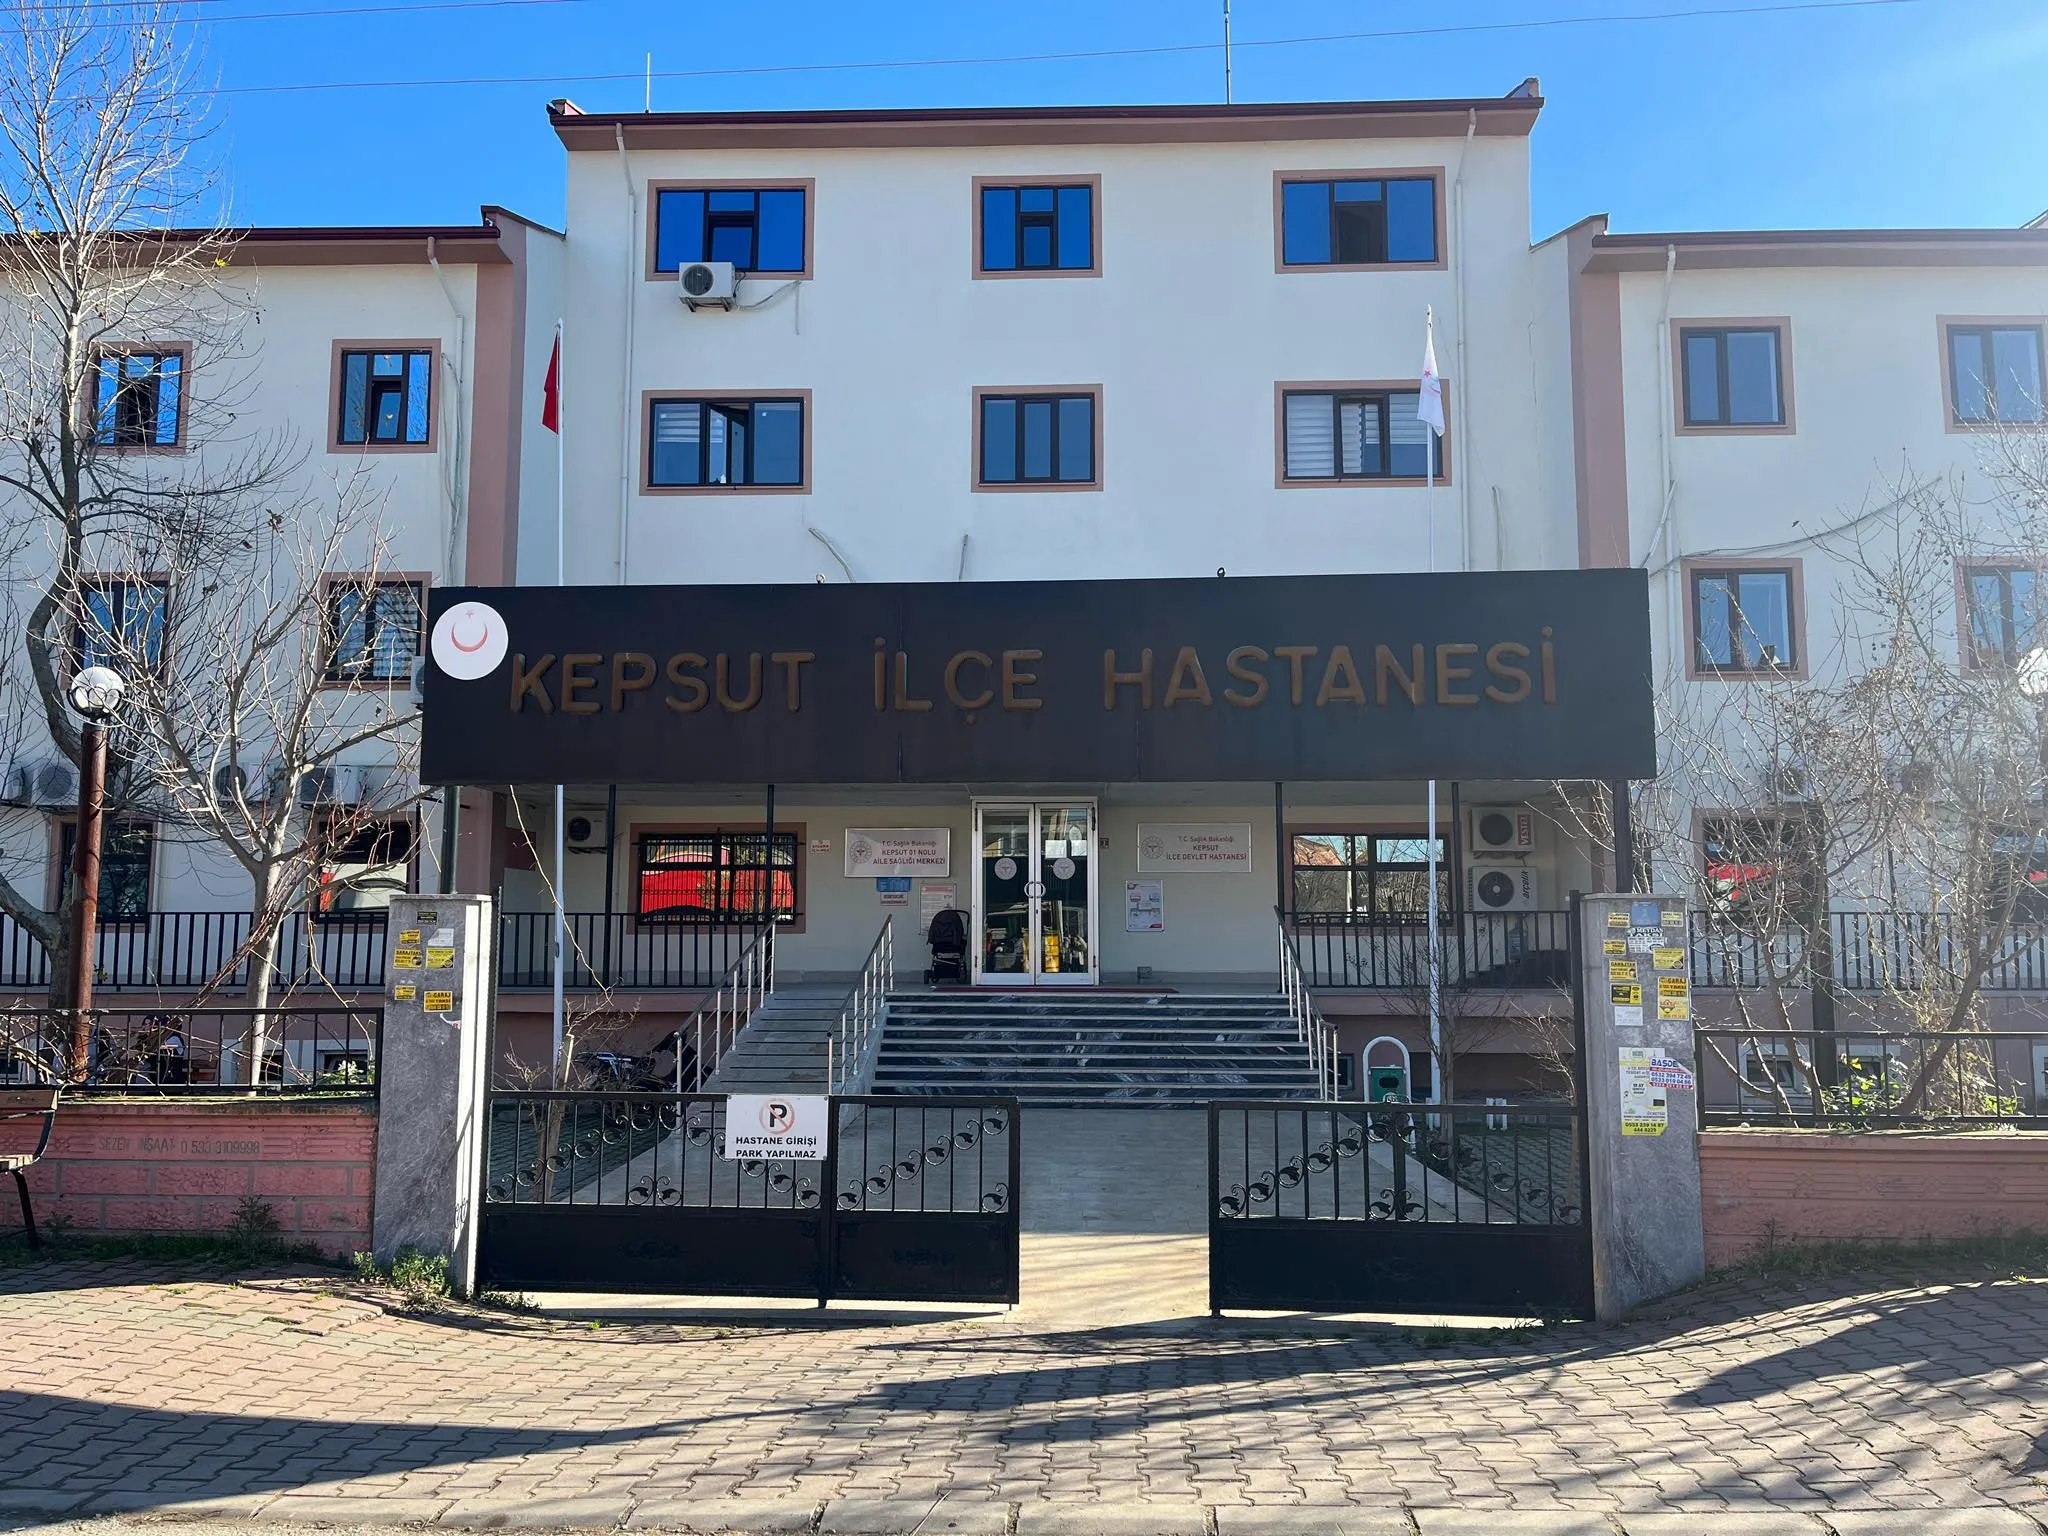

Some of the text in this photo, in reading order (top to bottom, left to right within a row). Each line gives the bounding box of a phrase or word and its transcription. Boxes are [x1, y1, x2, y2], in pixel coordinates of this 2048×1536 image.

[510, 625, 1557, 725] KEPSUT İLÇE HASTANESİ
[1520, 815, 1529, 845] VESTEL
[872, 857, 945, 865] AİLE SAĞLIĞI MERKEZİ
[1166, 852, 1181, 861] İLÇE
[1208, 852, 1247, 860] HASTANESİ
[735, 1135, 817, 1147] HASTANE GİRİŞİ
[736, 1149, 817, 1158] PARK YAPILMAZ
